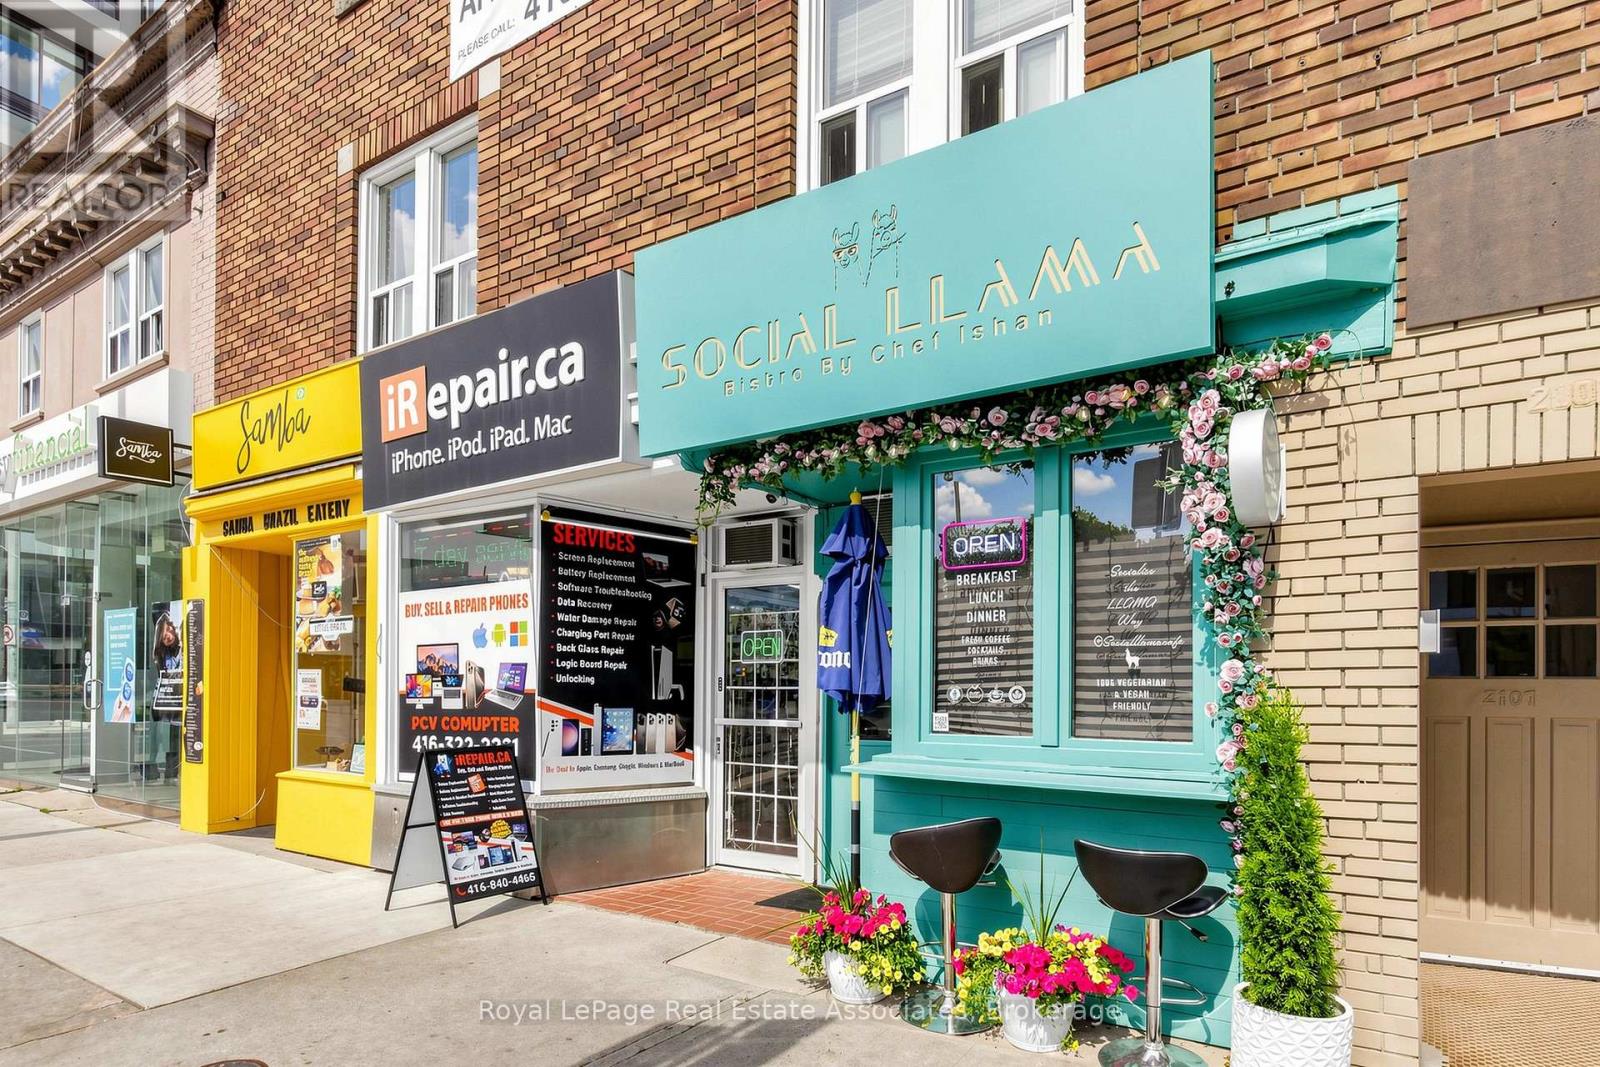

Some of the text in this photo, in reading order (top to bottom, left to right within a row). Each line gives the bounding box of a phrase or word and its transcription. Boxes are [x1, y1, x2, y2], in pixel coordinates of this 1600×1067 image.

[457, 33, 489, 61] PLEASE
[661, 221, 1161, 389] SOCIAL LLAMA
[724, 308, 1053, 397] Bistro By Chef Ishan
[387, 341, 585, 432] iRepair.ca
[237, 389, 312, 475] Samba
[534, 414, 573, 442] Mac
[116, 436, 162, 462] Samba
[307, 498, 350, 523] EATERY
[553, 523, 636, 553] SERVICES
[953, 531, 1015, 555] OPEN
[558, 552, 635, 568] Screen Replacement
[558, 567, 636, 583] Battery Replacement
[956, 570, 1018, 586] BREAKFAST
[557, 582, 652, 601] Software Troubleshooting
[1123, 580, 1140, 593] the
[424, 601, 445, 617] SELL
[445, 602, 452, 615] &
[454, 597, 487, 614] REPAIR
[489, 593, 529, 611] PHONES
[557, 597, 613, 612] Data Recovery
[968, 590, 1004, 605] LUNCH
[557, 612, 637, 627] Water Damage Repair
[966, 609, 1006, 623] DINNER
[1117, 613, 1143, 629] Way
[556, 628, 635, 641] Charging Port Repair
[984, 634, 1011, 644] COFFEE
[556, 643, 625, 656] Back Glass Repair
[743, 637, 781, 657] OPEN
[967, 645, 1004, 655] COCKTAILS
[556, 658, 627, 671] Logic Board Repair
[556, 674, 595, 685] Unlocking
[1117, 678, 1167, 687] VEGETARIAN
[1122, 690, 1150, 699] VEGAN
[1112, 702, 1152, 711] FRIENDLY
[411, 716, 520, 732] PCV COMUPTER
